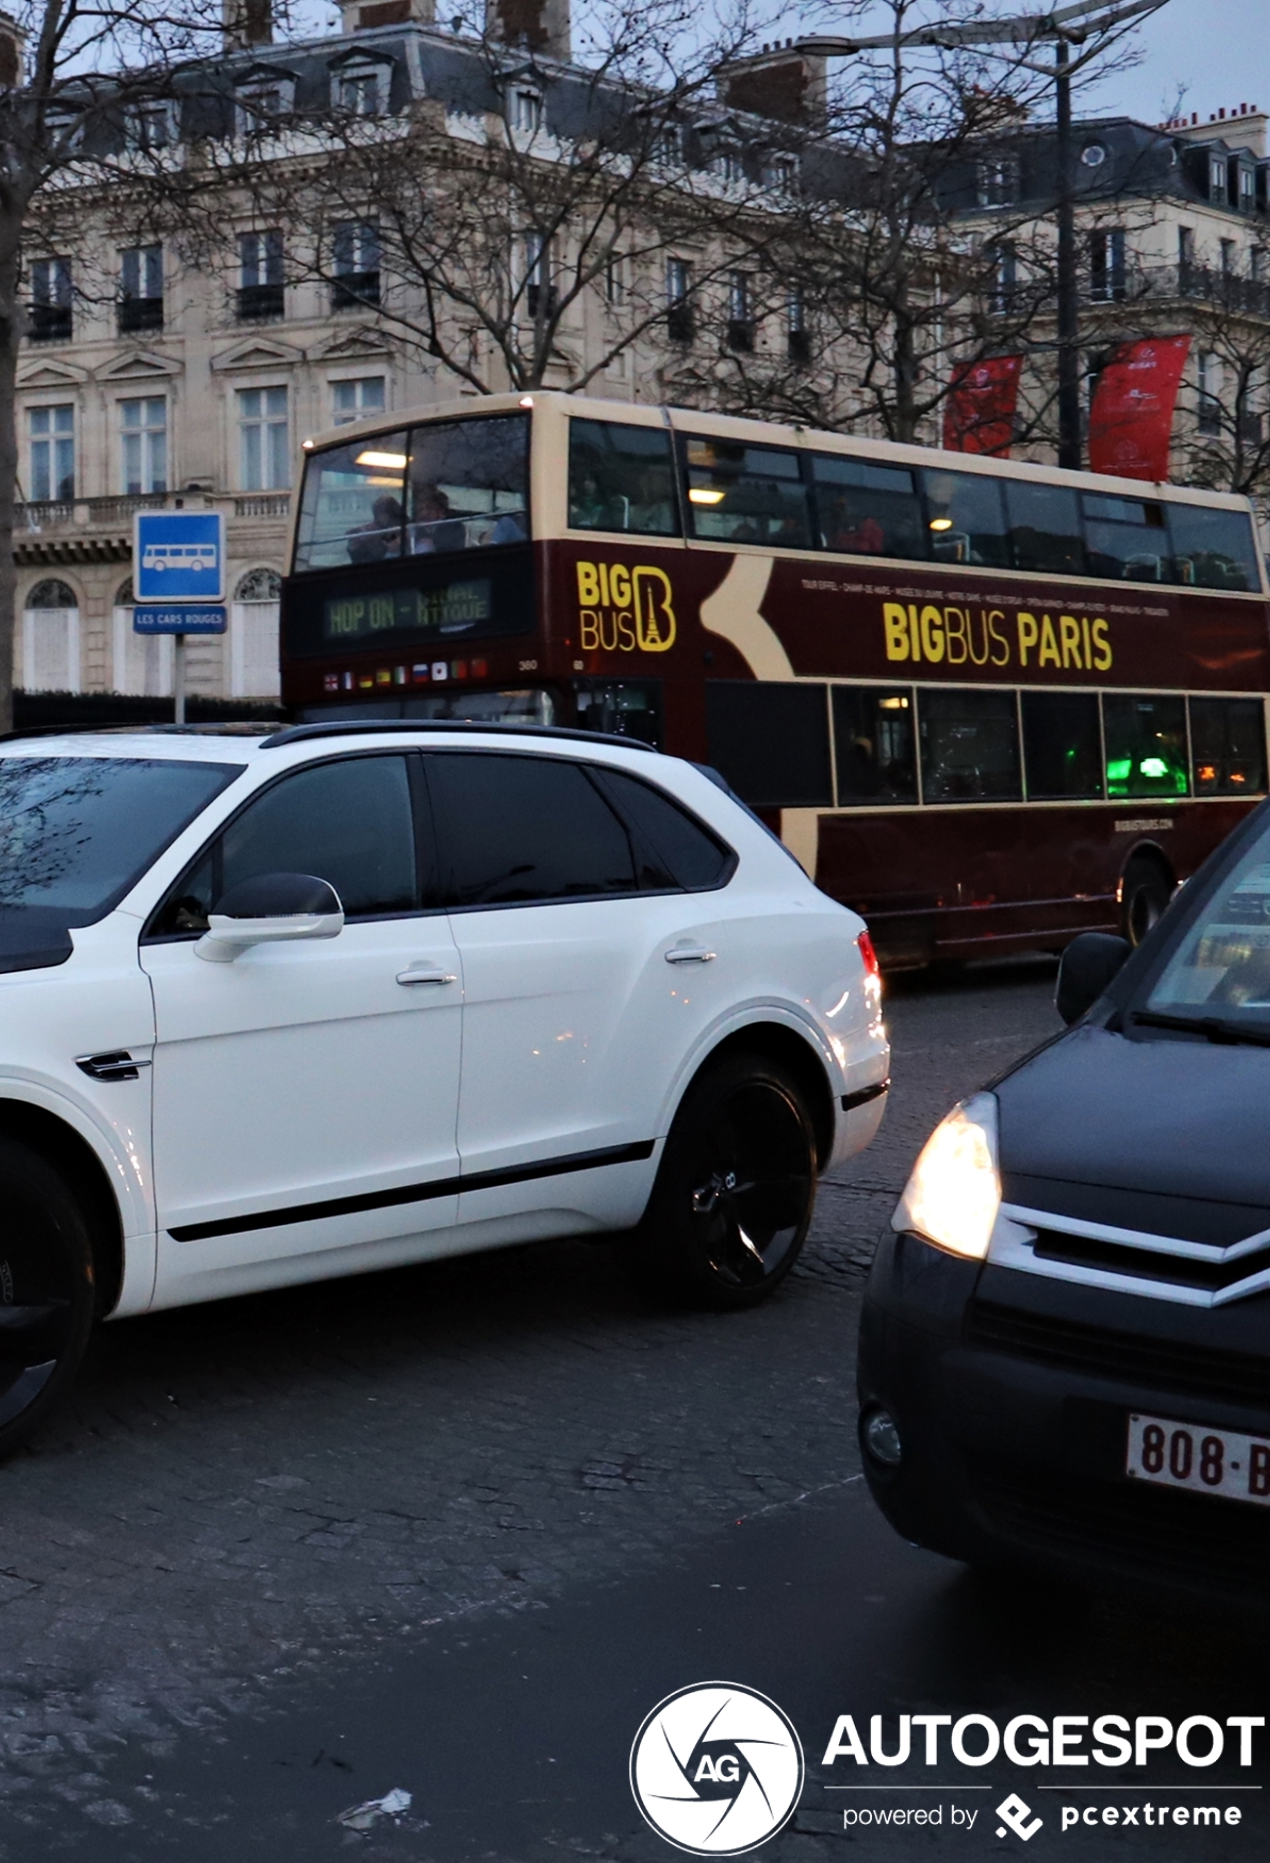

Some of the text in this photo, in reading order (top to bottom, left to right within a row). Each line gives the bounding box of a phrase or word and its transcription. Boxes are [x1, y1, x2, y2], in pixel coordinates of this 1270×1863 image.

[576, 561, 632, 608] BIG
[137, 614, 223, 625] LES CARS ROUGES
[330, 600, 365, 634] HOP
[369, 597, 395, 629] ON
[579, 609, 636, 652] BUS
[1016, 611, 1114, 672] PARIS
